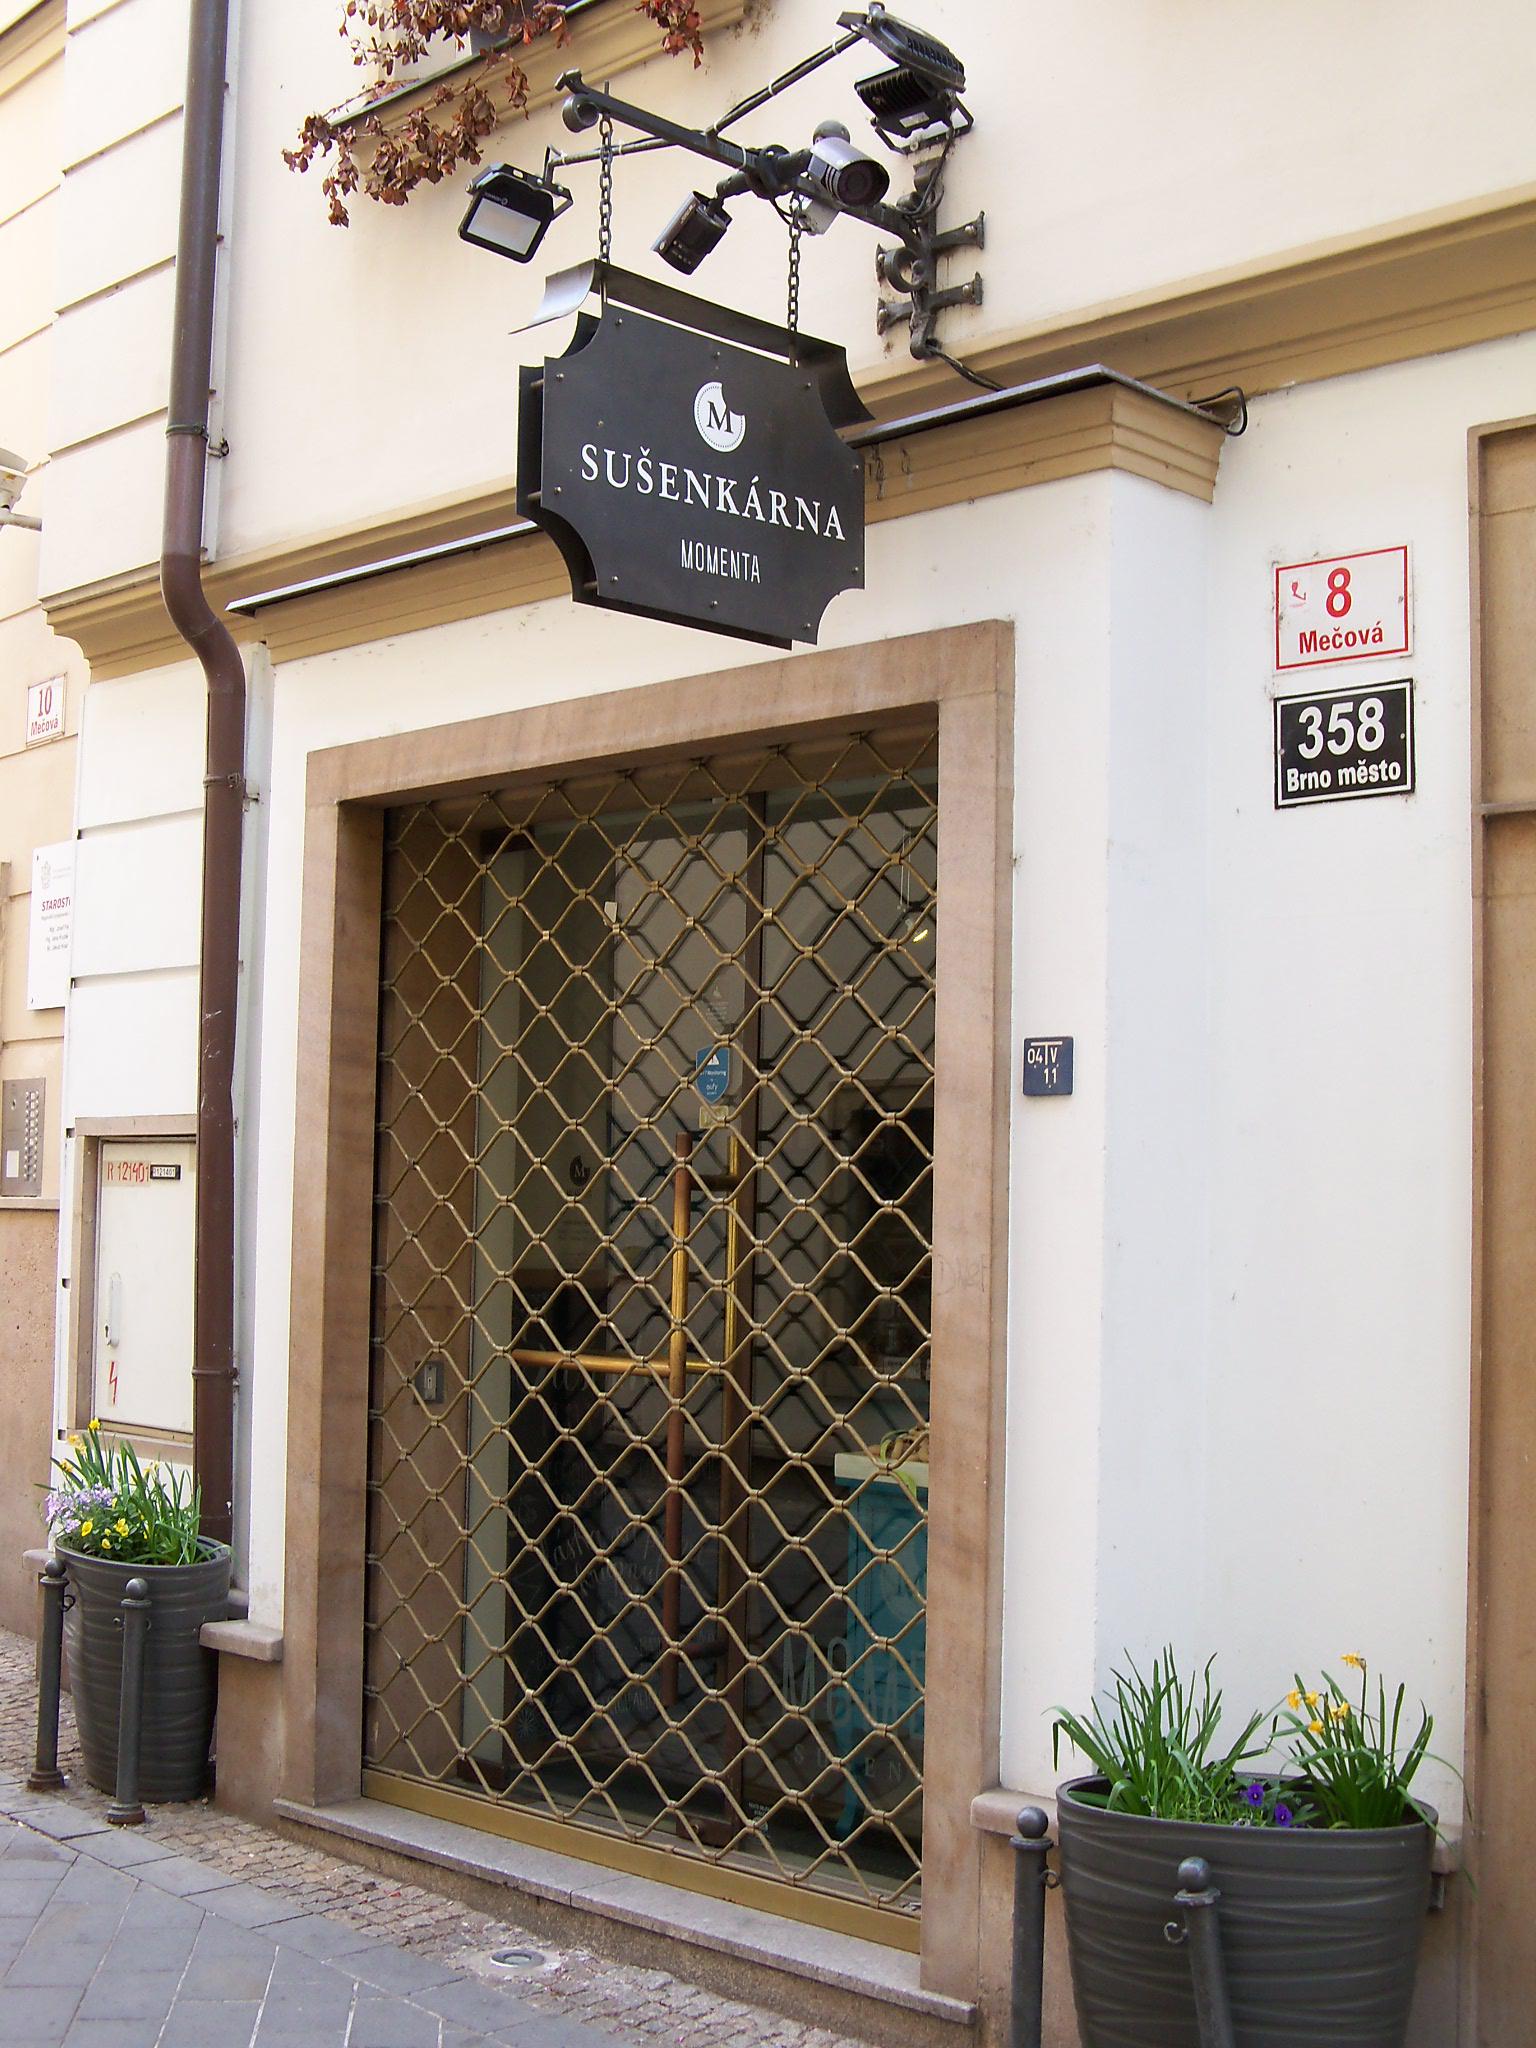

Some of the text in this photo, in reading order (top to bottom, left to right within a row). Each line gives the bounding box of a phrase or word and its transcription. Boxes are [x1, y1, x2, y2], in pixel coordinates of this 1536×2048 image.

[706, 400, 734, 434] M
[580, 443, 846, 541] SUŠENKÁRNA
[681, 539, 761, 584] MOMENTA
[1325, 567, 1352, 618] 8
[1298, 621, 1384, 654] Mečová
[38, 685, 53, 717] 10
[31, 714, 59, 737] Mečová
[1297, 697, 1385, 760] 358
[1286, 758, 1401, 793] Brno město
[41, 896, 71, 912] STAROST
